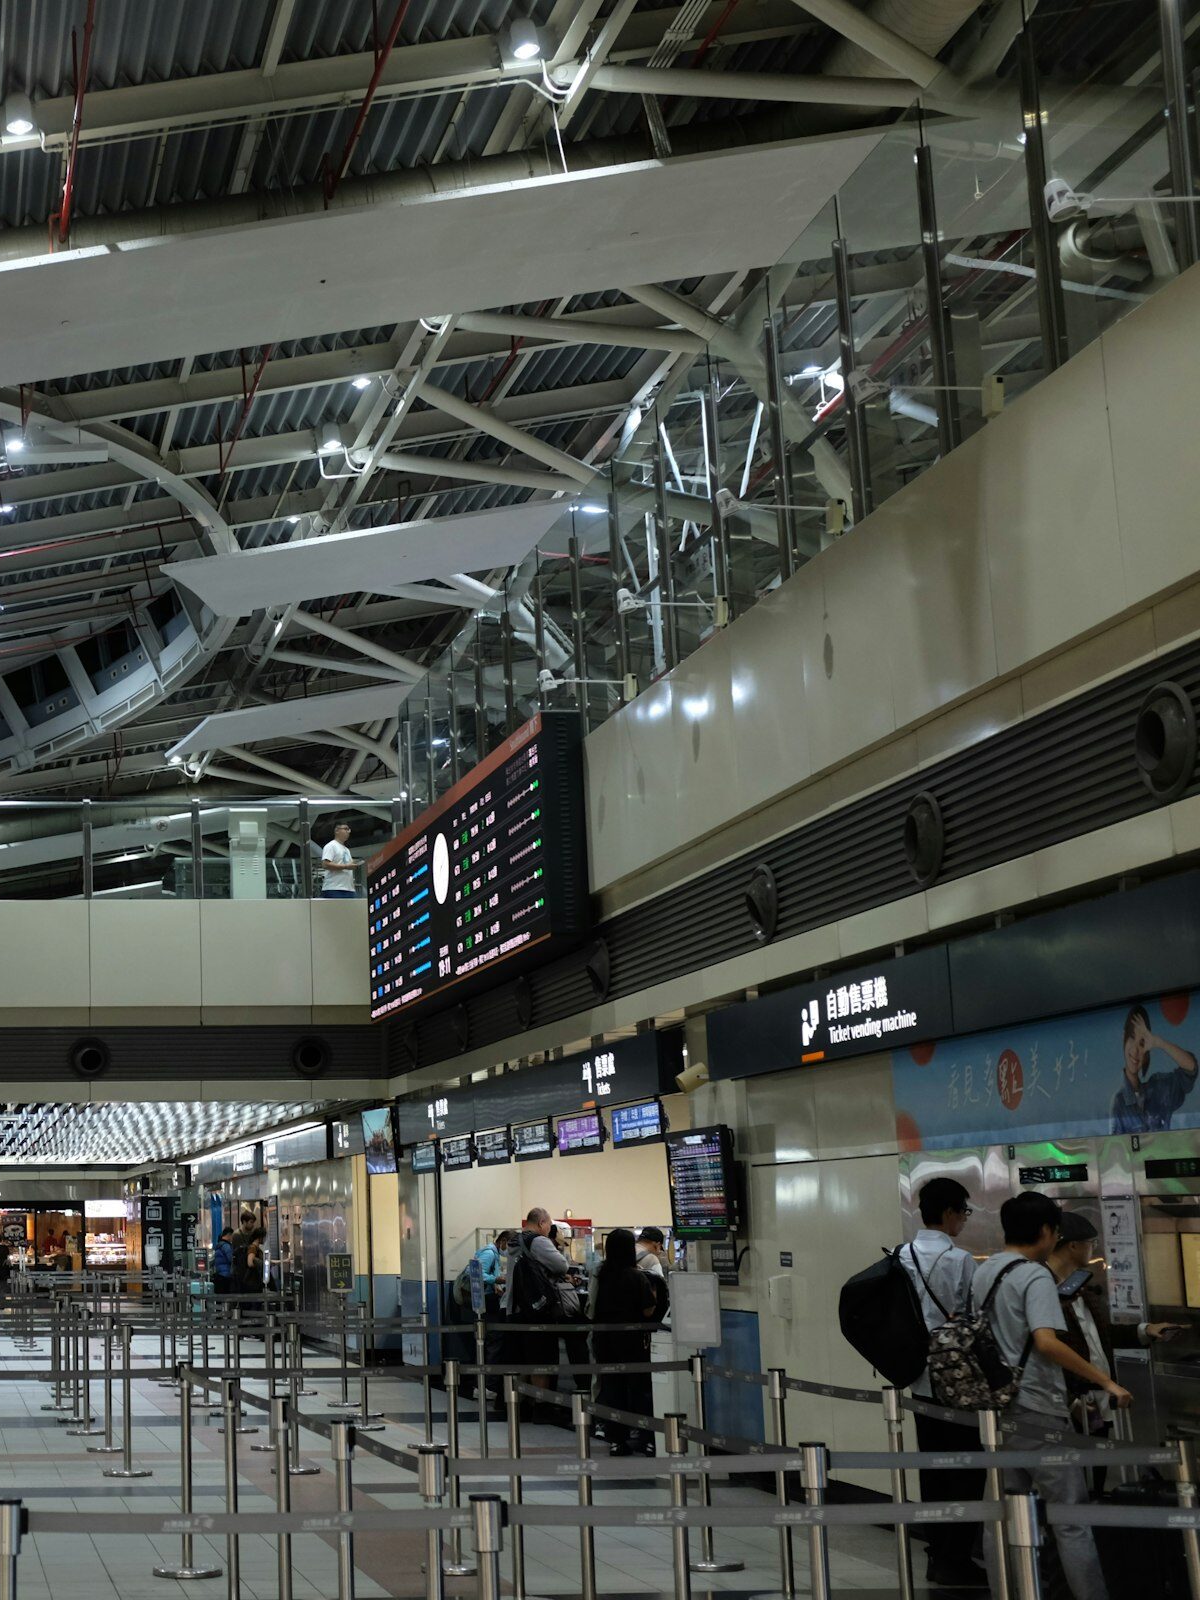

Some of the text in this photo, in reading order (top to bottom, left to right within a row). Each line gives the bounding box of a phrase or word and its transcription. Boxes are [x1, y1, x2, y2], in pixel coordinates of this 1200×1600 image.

[826, 975, 888, 1021] 自動售票機
[828, 1009, 917, 1044] Ticket vending machine
[331, 1257, 351, 1268] 出口
[334, 1270, 348, 1278] Exit
